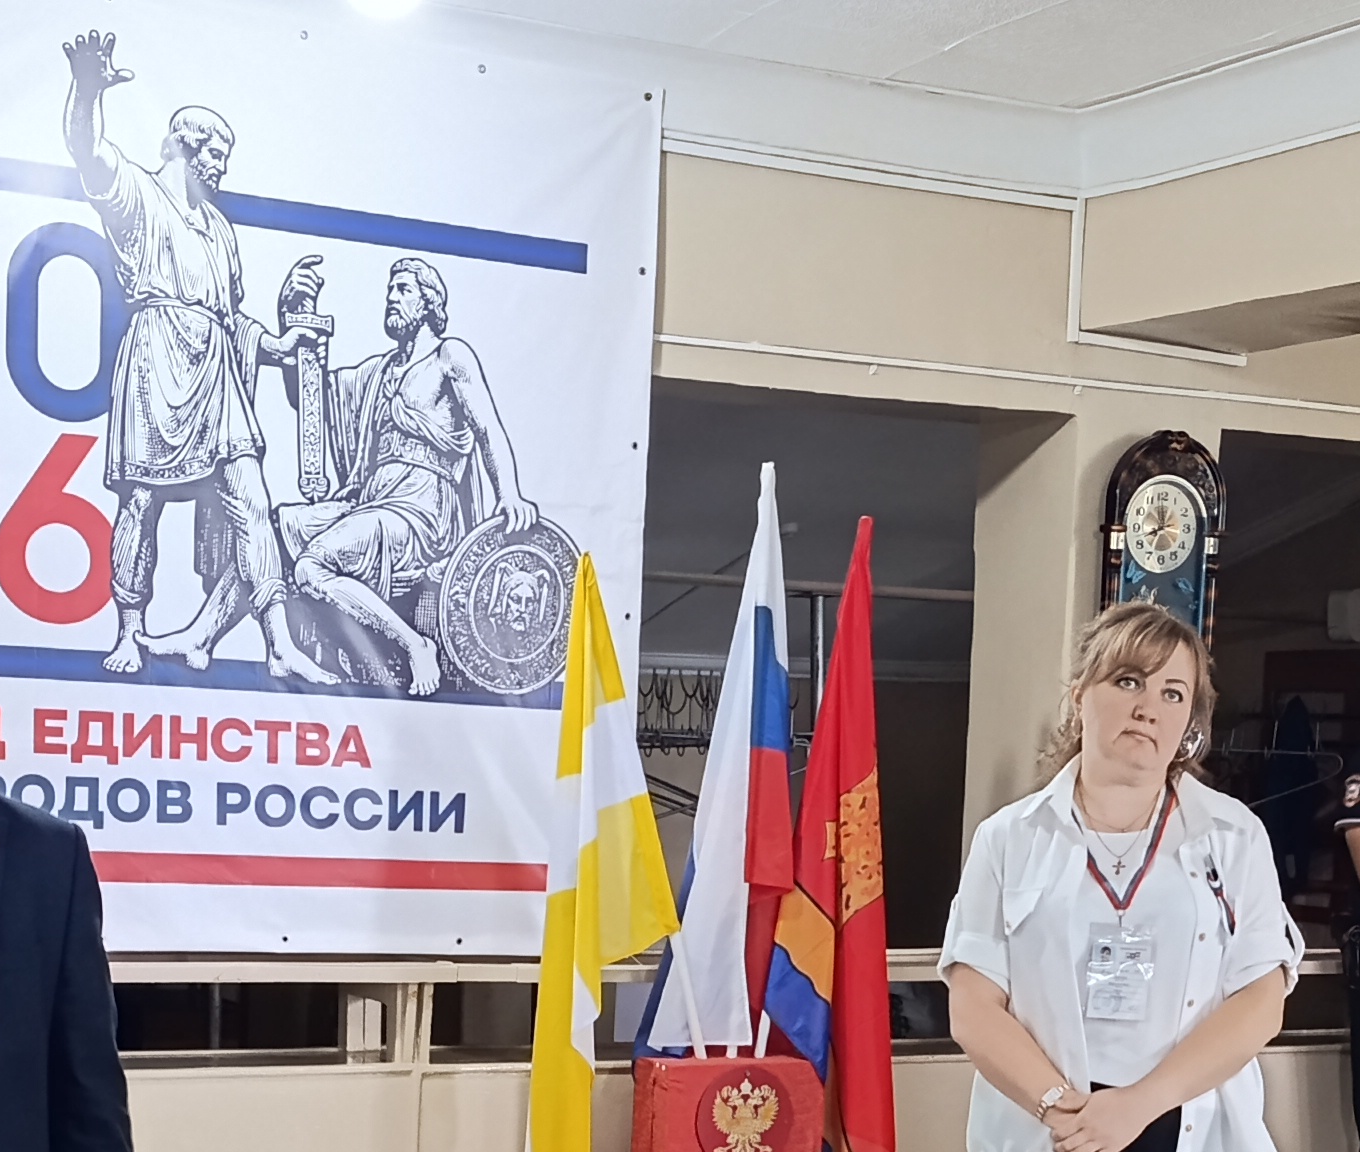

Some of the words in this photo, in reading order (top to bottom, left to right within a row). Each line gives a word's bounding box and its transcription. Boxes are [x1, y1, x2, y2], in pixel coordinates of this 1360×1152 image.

[1157, 492, 1168, 502] 12
[1136, 506, 1145, 516] 10
[1180, 508, 1188, 517] 2
[1132, 523, 1140, 532] 9
[1182, 524, 1190, 534] 3
[1136, 540, 1144, 550] 8
[1178, 541, 1186, 550] 4
[1146, 552, 1153, 560] 7
[1157, 555, 1165, 565] 6
[1170, 551, 1178, 561] 5
[32, 707, 372, 769] ЕДИНСТВА
[216, 781, 467, 834] РОССИИ
